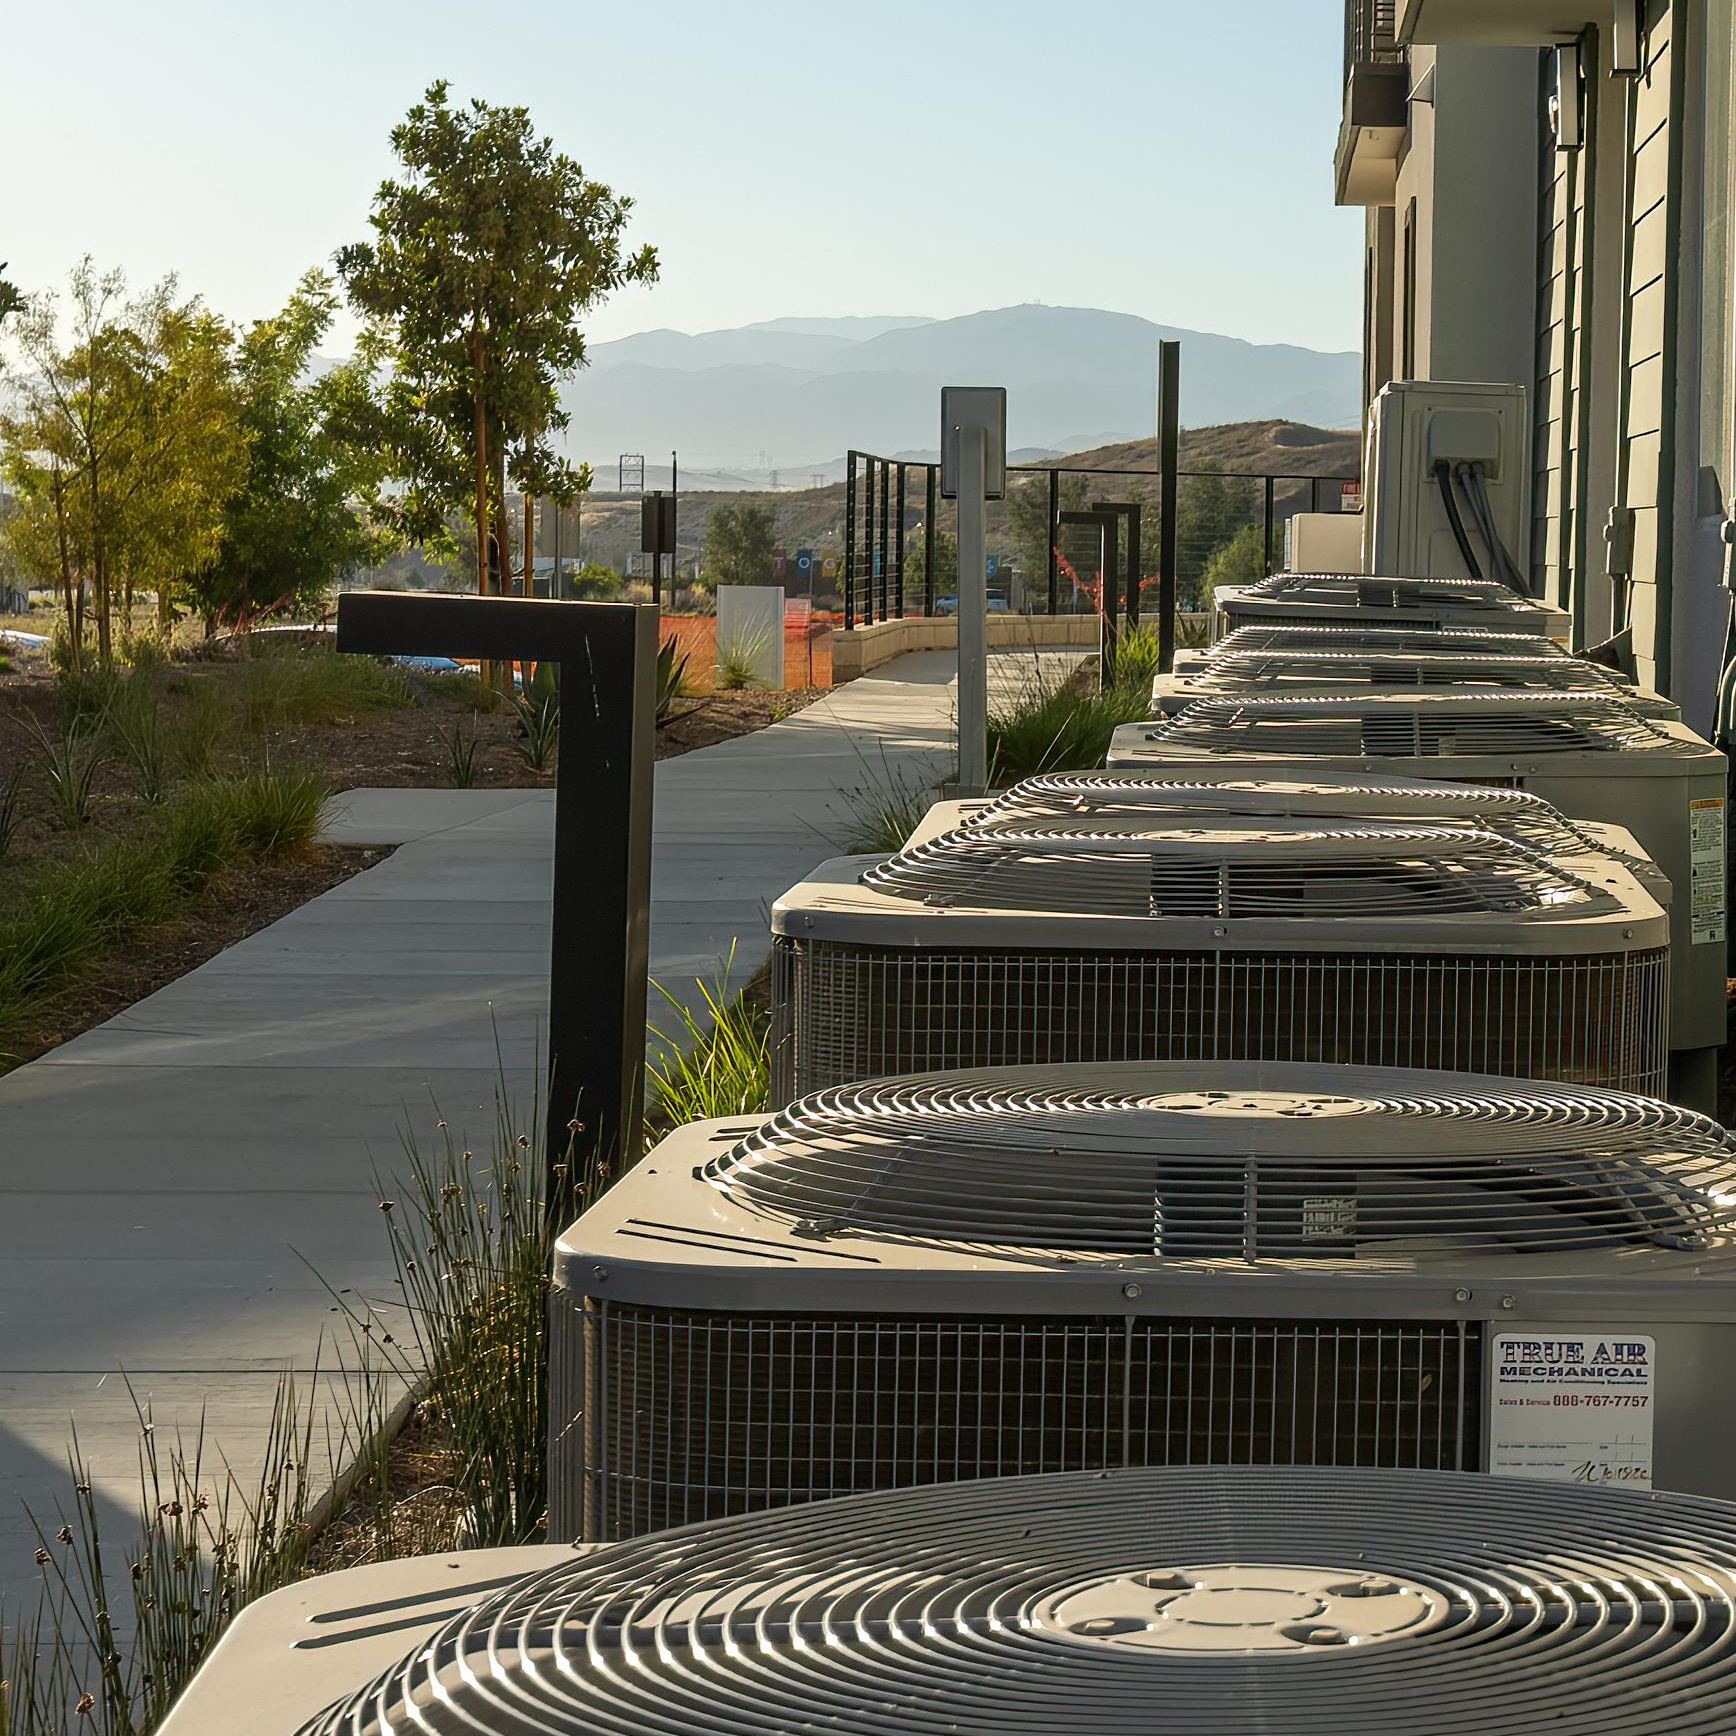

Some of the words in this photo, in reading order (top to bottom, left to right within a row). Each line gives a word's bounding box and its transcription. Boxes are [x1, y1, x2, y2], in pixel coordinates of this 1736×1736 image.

[1500, 1341, 1585, 1364] TRUE
[1591, 1342, 1649, 1365] AIR
[1500, 1366, 1648, 1378] MECHANICAL
